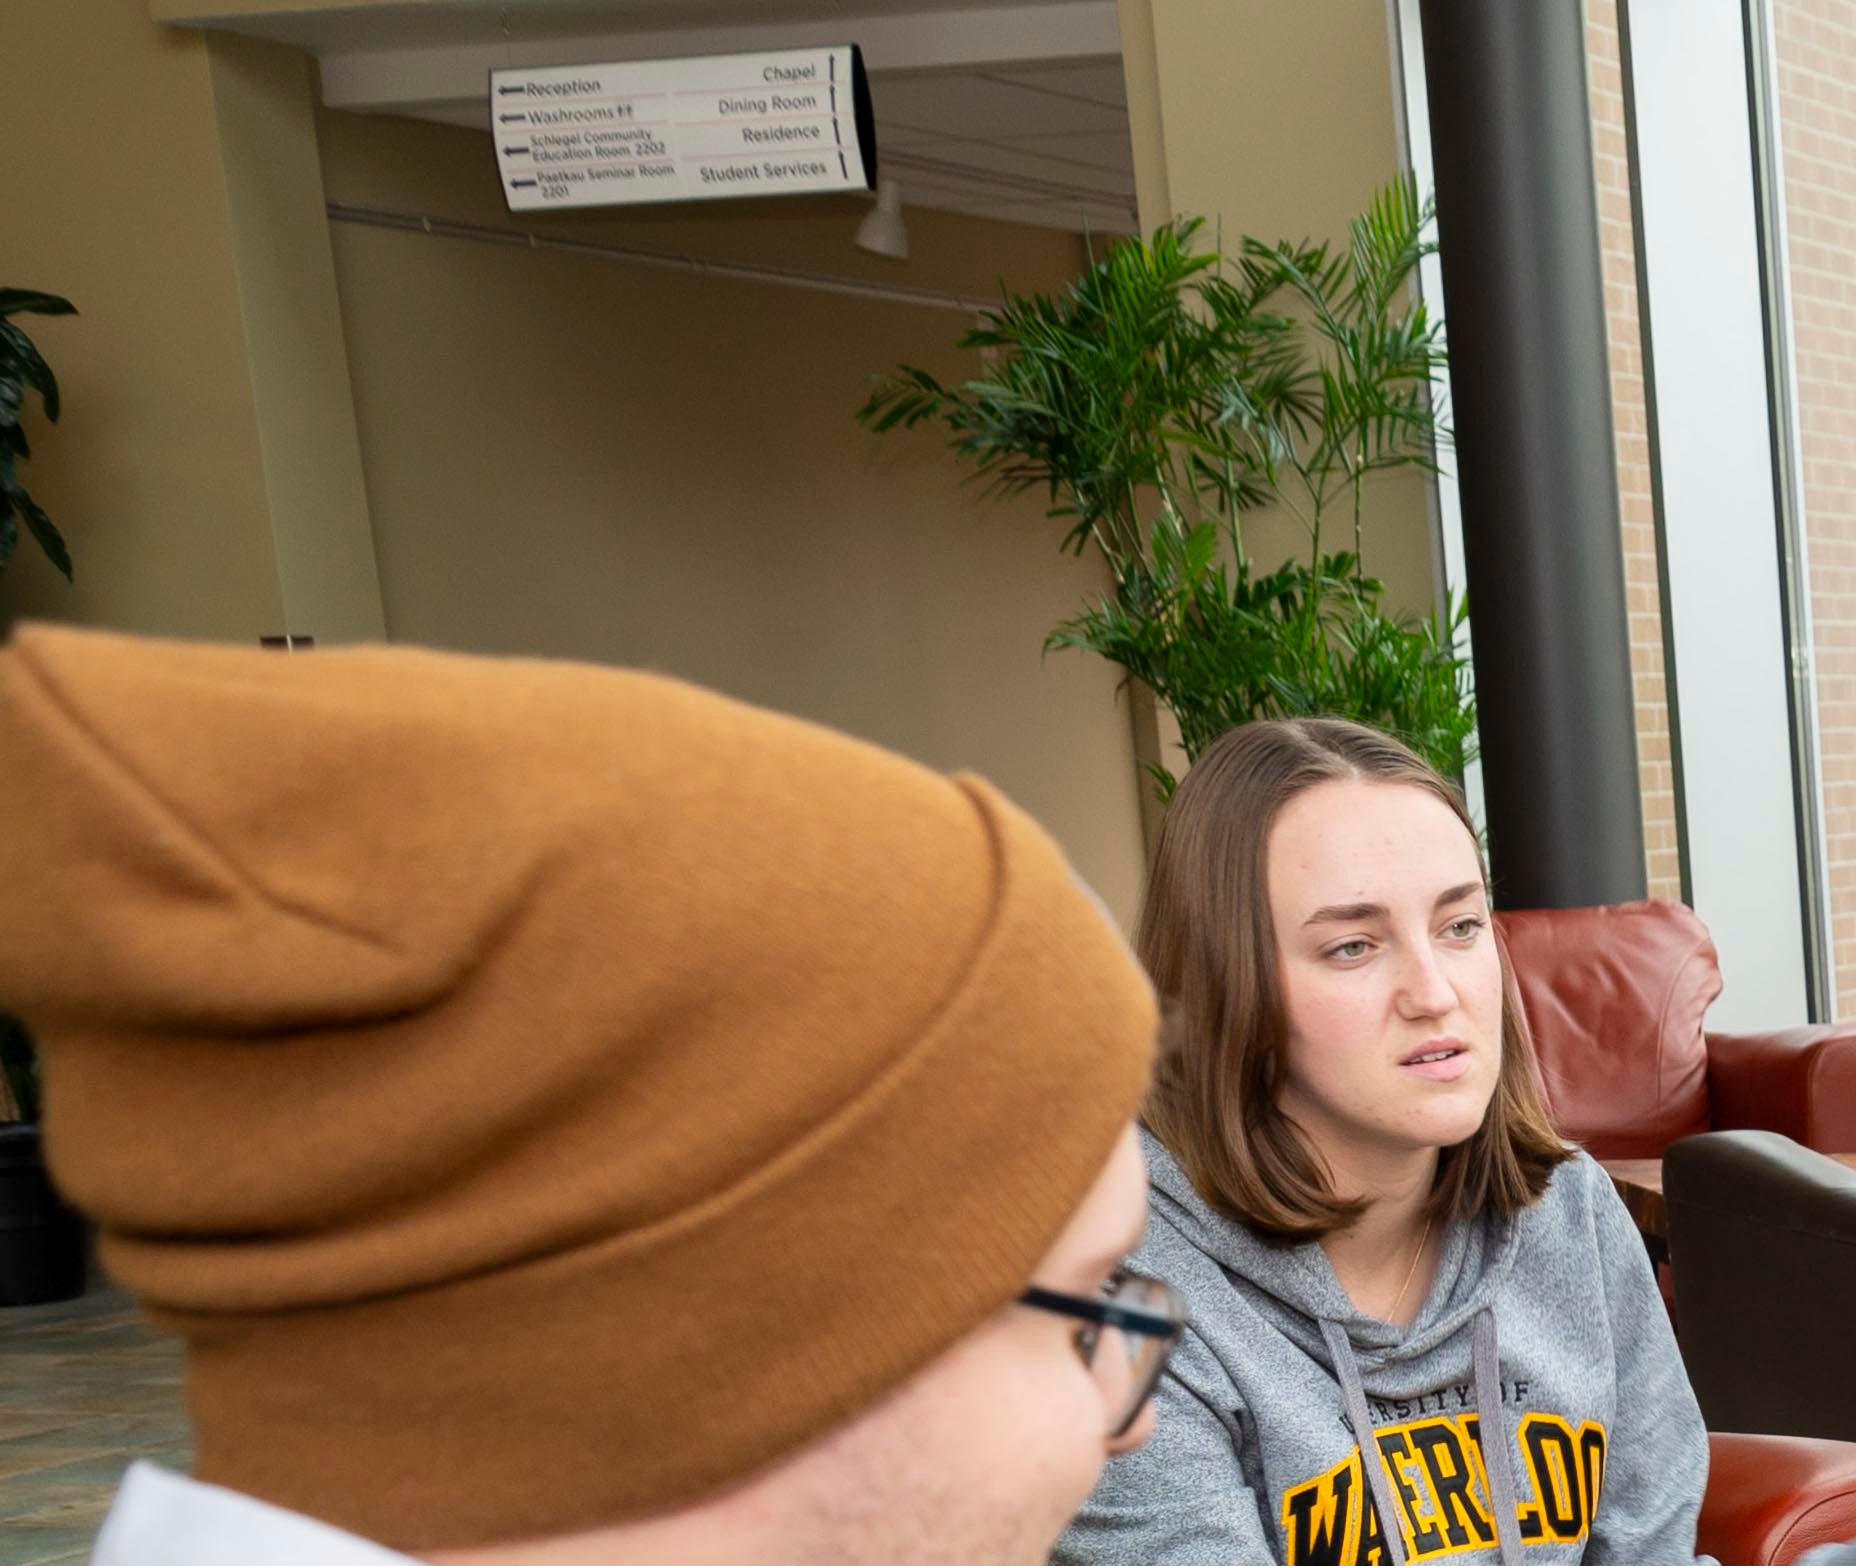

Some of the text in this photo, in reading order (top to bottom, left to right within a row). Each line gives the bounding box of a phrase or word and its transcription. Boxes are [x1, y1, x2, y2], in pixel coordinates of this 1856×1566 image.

[763, 63, 816, 81] Chapel
[527, 79, 602, 97] Reception
[718, 95, 816, 114] Dining Room
[528, 107, 615, 124] Washrooms
[530, 128, 652, 147] Schlegel Community
[742, 125, 820, 143] Residence
[532, 141, 666, 162] Education Room 2202
[587, 166, 635, 180] Seminar
[638, 164, 676, 177] Room
[700, 160, 827, 183] Student Services
[541, 184, 570, 199] 2201
